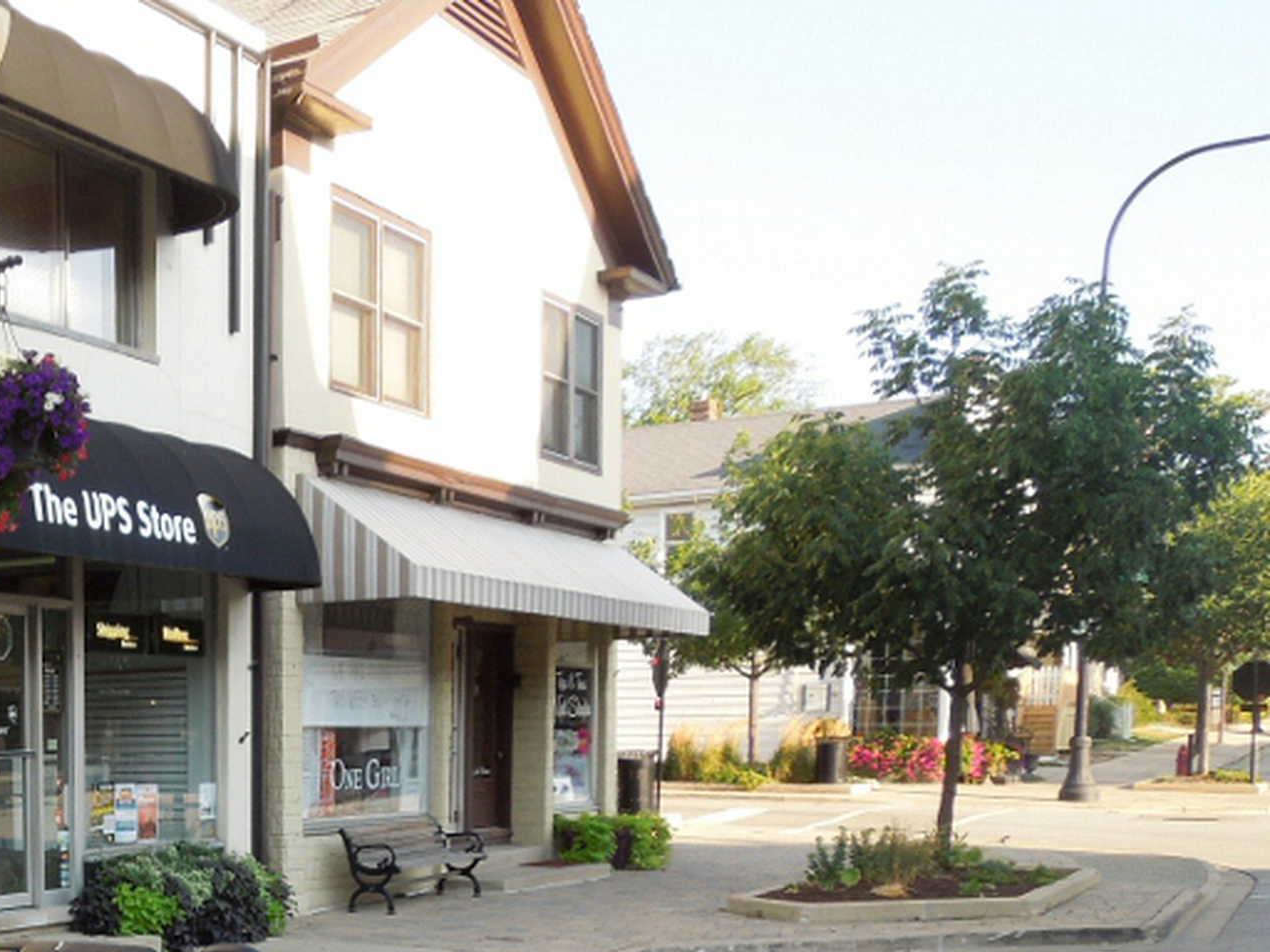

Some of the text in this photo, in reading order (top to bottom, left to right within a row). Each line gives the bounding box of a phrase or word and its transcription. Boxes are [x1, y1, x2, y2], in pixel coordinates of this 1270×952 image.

[29, 482, 198, 545] The UPS Store
